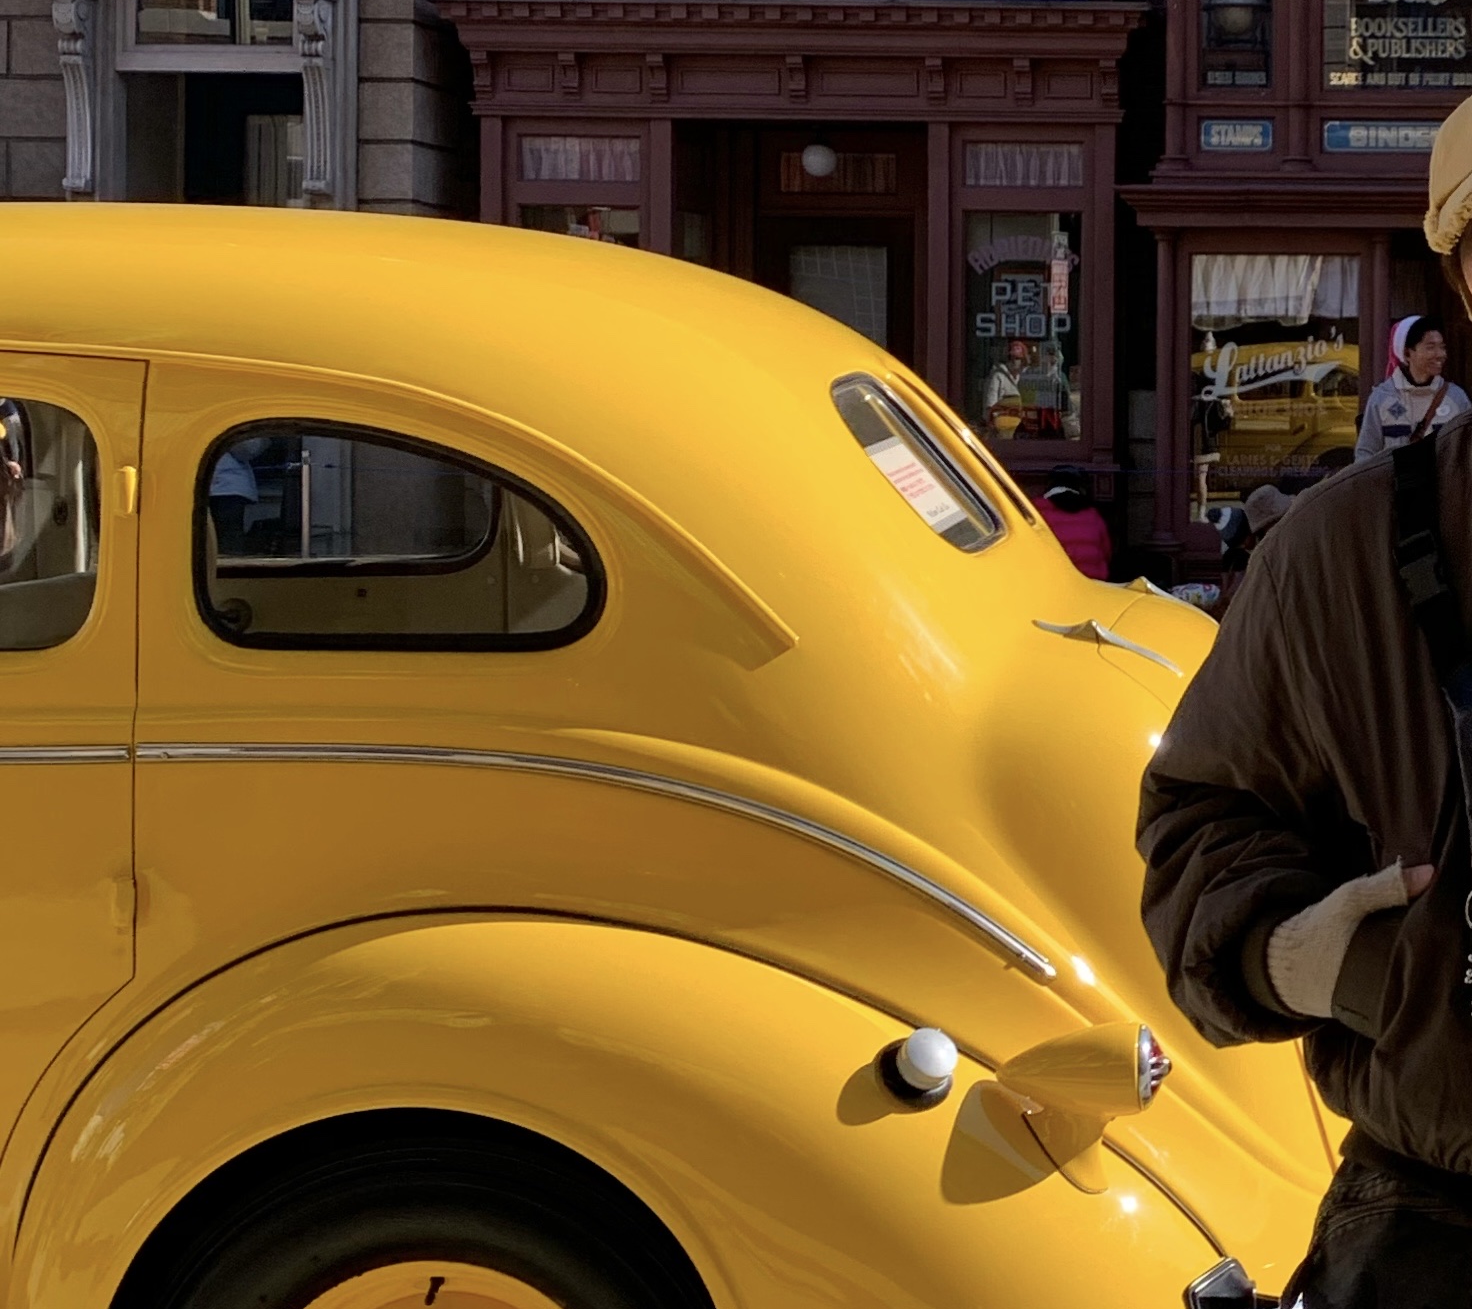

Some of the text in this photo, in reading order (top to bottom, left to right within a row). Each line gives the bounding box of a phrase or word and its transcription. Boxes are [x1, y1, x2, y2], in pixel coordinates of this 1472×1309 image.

[1350, 16, 1467, 37] BOOKSELLERS
[1350, 37, 1467, 65] & PUBLISHERS
[1210, 125, 1263, 146] STAMPS
[991, 282, 1059, 306] PET
[976, 312, 1072, 338] SHOP
[1201, 325, 1344, 400] Lattanzio's
